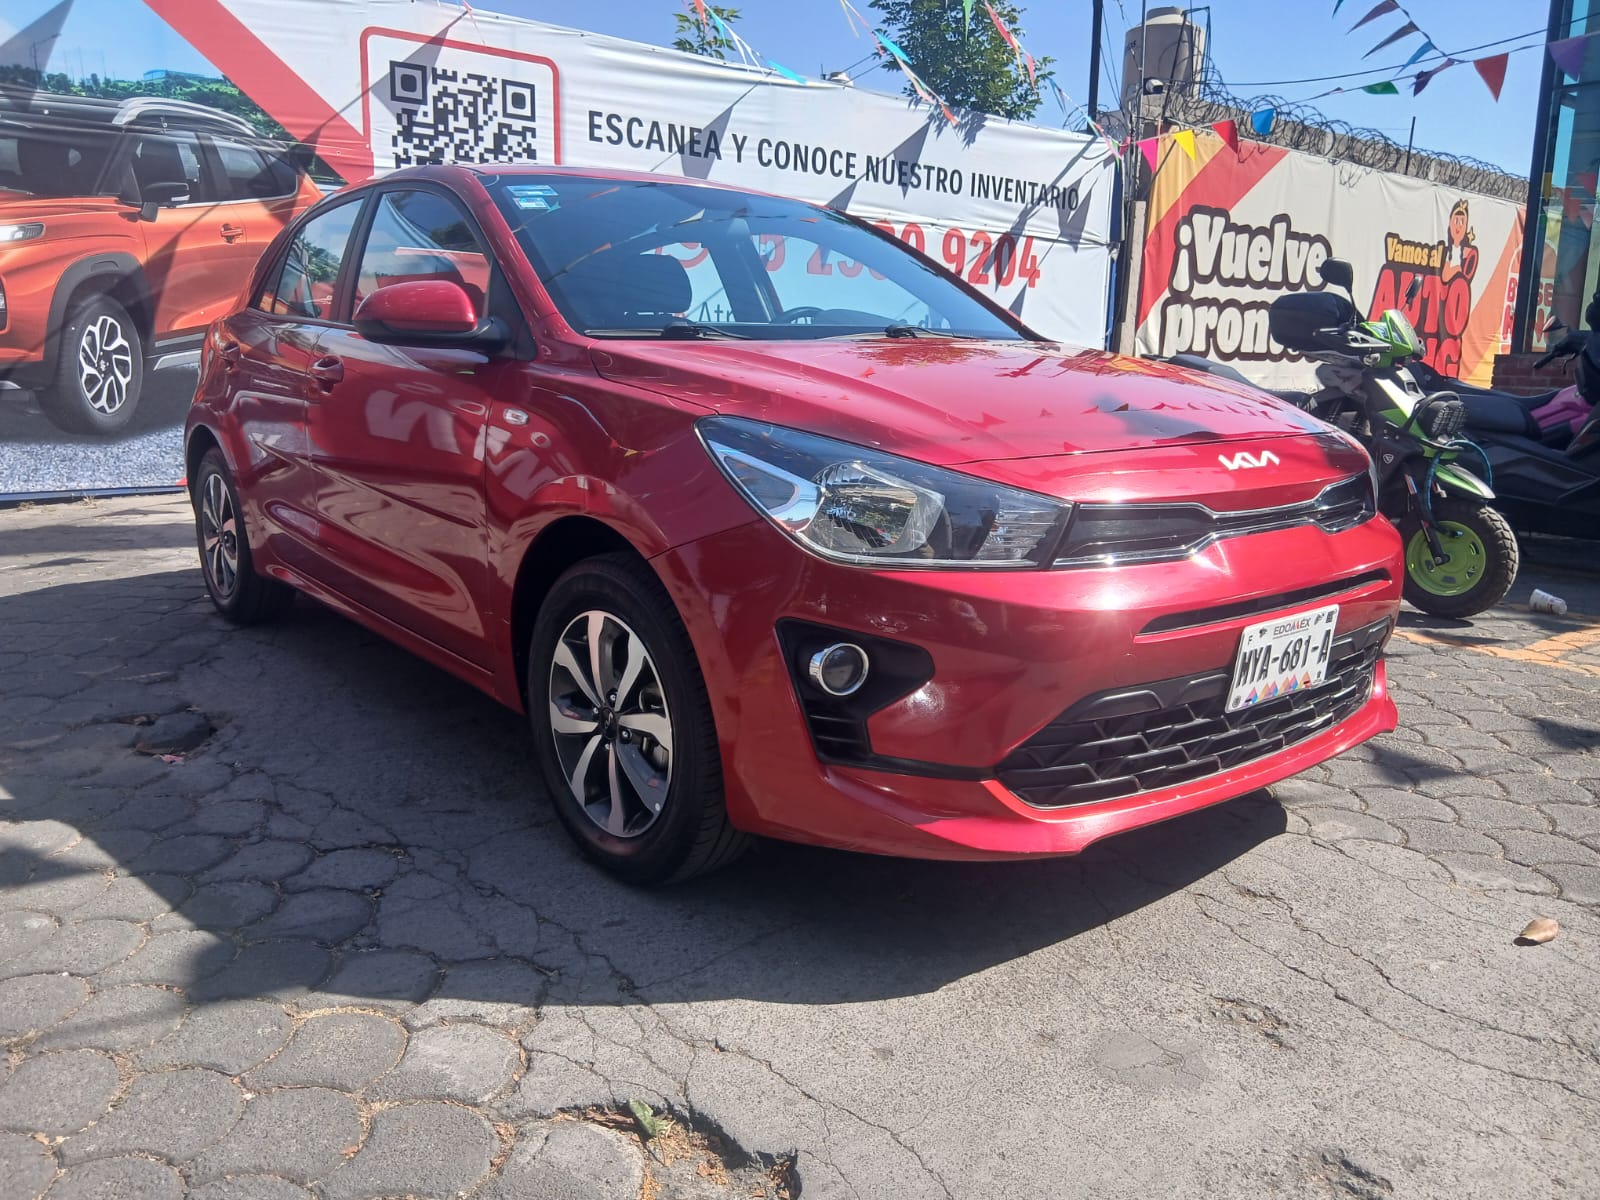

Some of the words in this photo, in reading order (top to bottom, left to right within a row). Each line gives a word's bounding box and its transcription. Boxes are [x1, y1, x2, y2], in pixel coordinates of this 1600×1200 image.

[588, 109, 723, 161] ESCANEA
[731, 133, 748, 163] Y
[757, 138, 857, 180] CONOCE
[864, 154, 964, 196] NUESTRO
[970, 172, 1080, 212] INVENTARIO
[942, 227, 1041, 289] 9204
[1172, 213, 1329, 293] ¡Vuelve
[1386, 237, 1429, 267] Vamos
[1429, 243, 1444, 269] al
[1162, 302, 1300, 358] pron
[1367, 268, 1472, 337] AUTO
[1218, 449, 1281, 471] KIA
